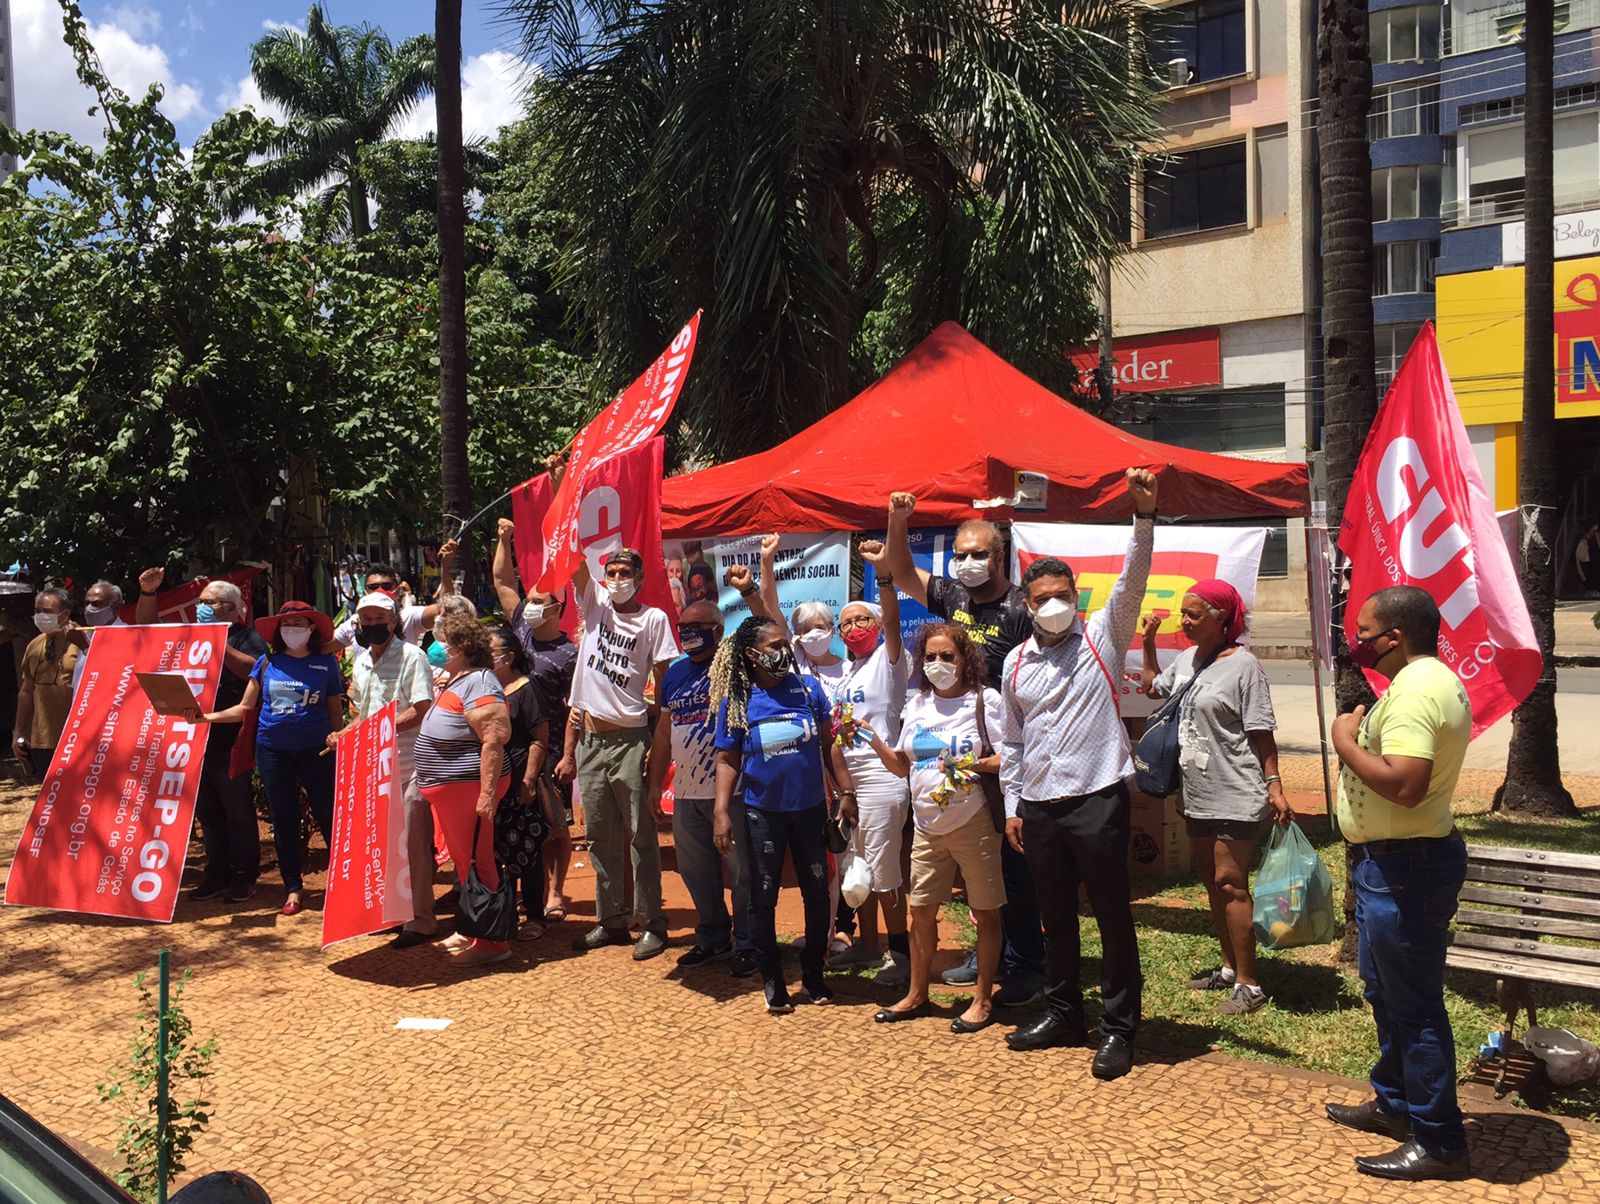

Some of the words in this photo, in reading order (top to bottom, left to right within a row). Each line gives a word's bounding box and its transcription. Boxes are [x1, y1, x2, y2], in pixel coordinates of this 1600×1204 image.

[722, 554, 736, 568] DIA
[737, 553, 749, 566] DO
[807, 564, 840, 579] SOCIAL
[1383, 556, 1402, 583] DOS
[908, 616, 925, 628] pela
[587, 654, 596, 668] A
[1457, 640, 1496, 680] GO
[75, 671, 99, 716] Filiado
[72, 720, 81, 729] a
[136, 701, 154, 749] ederal
[59, 732, 79, 764] CUT
[66, 664, 135, 860] www.sintsepgo.org.br
[128, 756, 141, 771] no
[56, 767, 65, 777] e
[130, 730, 166, 822] Trabalhadores
[114, 779, 137, 824] Estado
[29, 780, 62, 858] CONDSEF
[124, 825, 138, 842] no
[108, 831, 122, 848] de
[96, 855, 116, 894] Goiás
[110, 846, 135, 896] Serviço
[364, 864, 375, 910] Goiás
